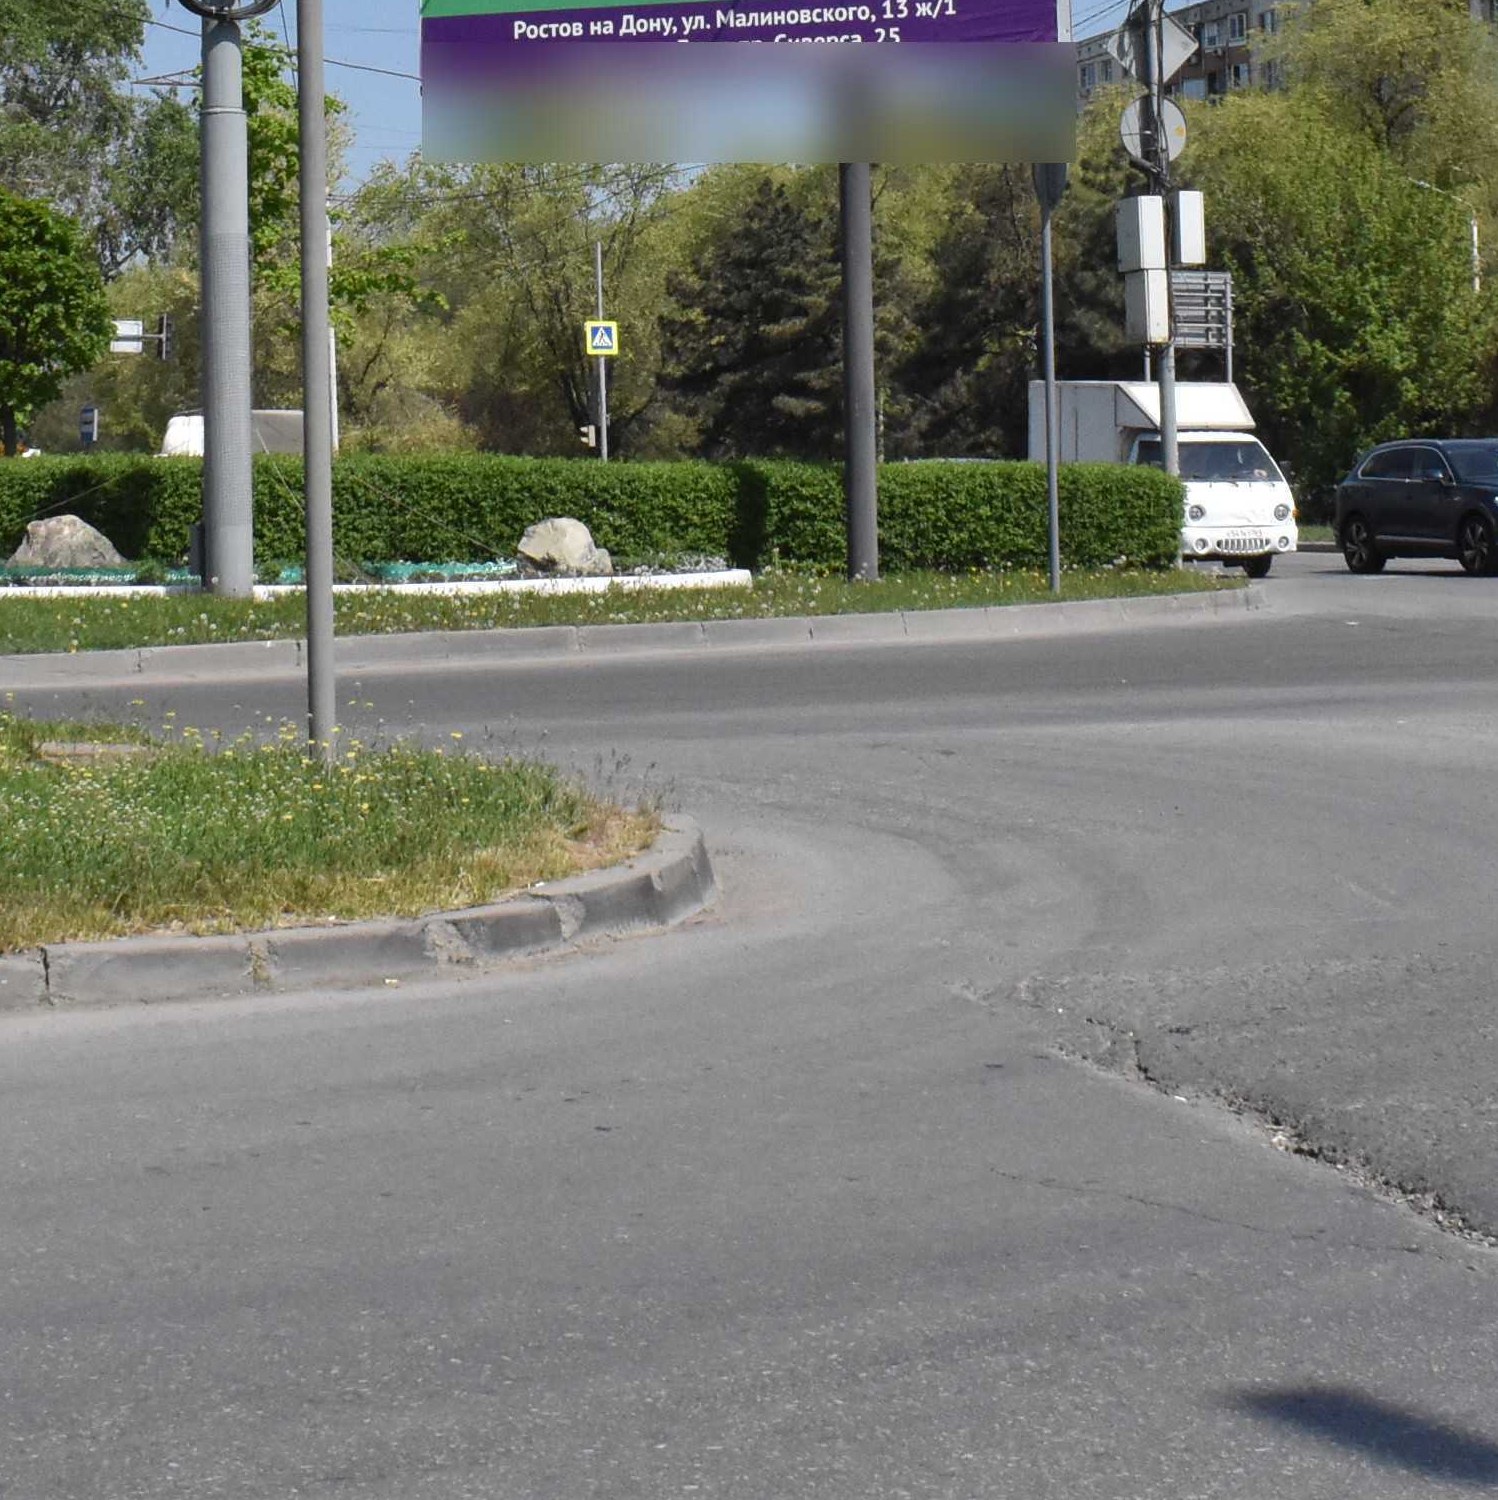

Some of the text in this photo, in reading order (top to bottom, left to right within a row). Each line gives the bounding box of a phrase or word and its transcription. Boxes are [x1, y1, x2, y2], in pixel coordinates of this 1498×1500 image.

[513, 20, 584, 40] Ростов
[589, 19, 614, 35] на
[619, 14, 678, 36] Дону,
[681, 15, 711, 35] ул.
[716, 4, 877, 29] Малиновского,
[882, 0, 908, 19] 13
